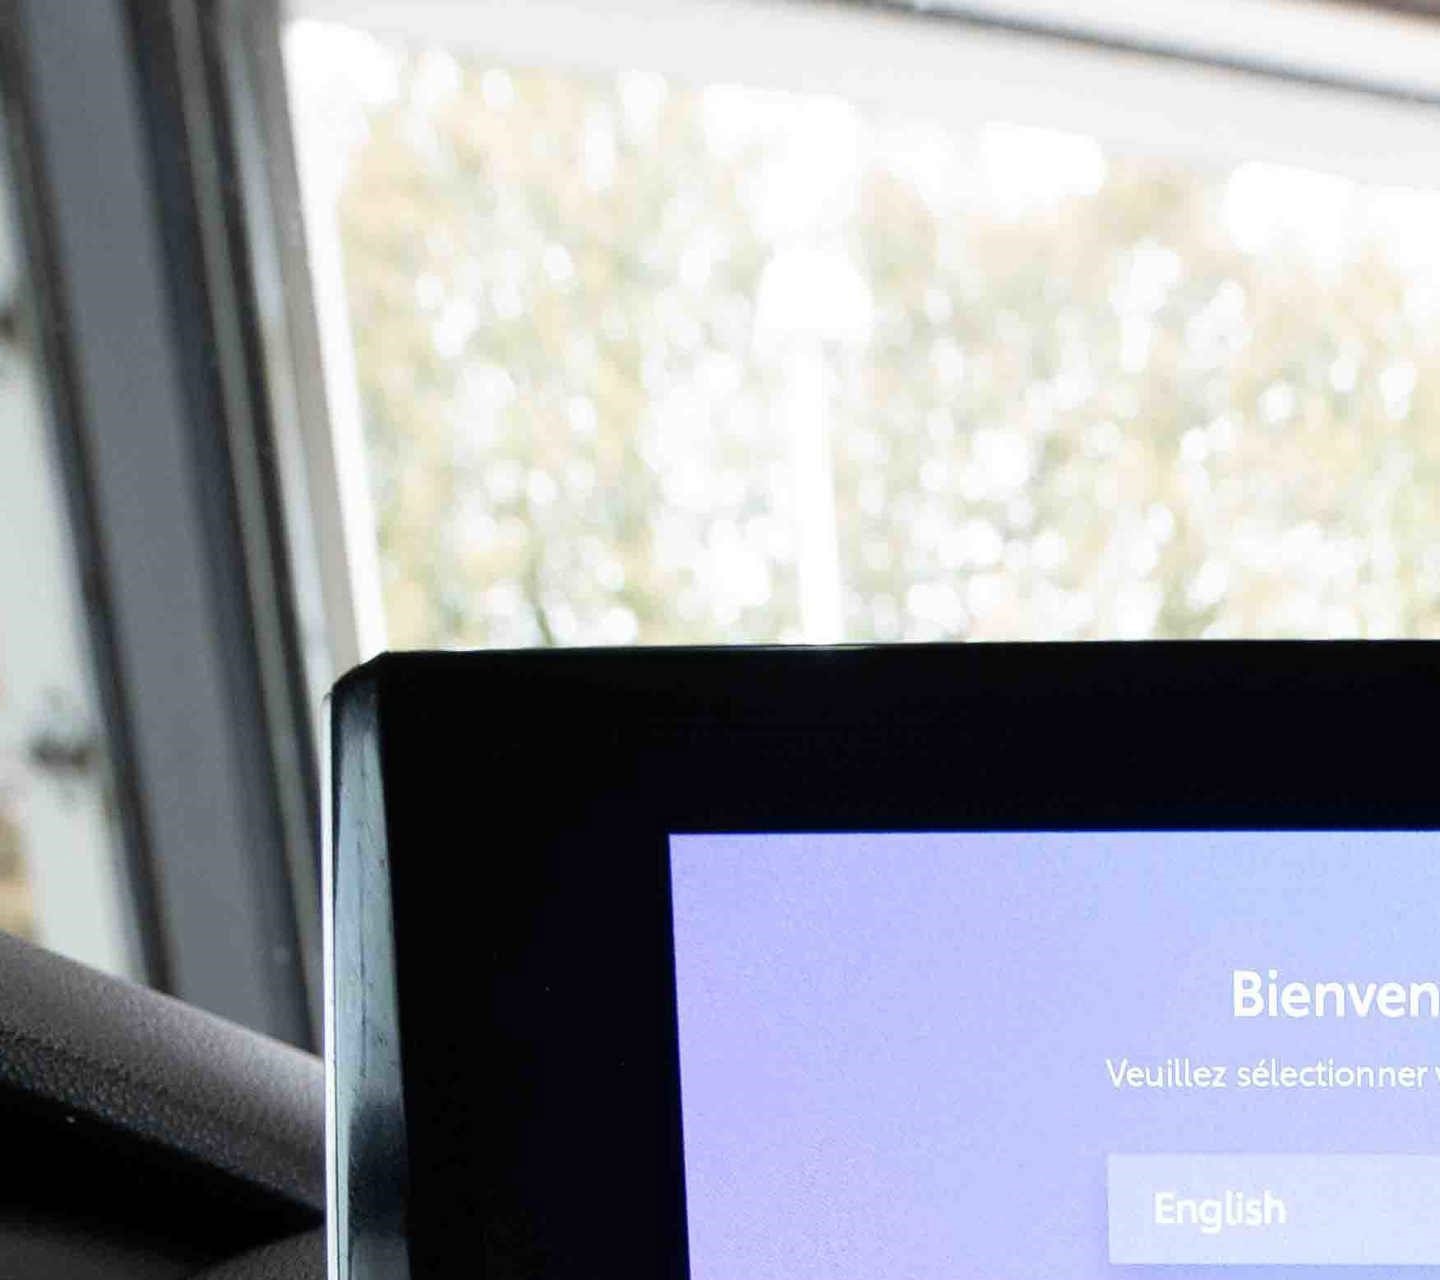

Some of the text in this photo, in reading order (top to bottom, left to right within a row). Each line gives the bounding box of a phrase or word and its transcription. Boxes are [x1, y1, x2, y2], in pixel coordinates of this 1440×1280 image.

[1106, 1059, 1227, 1089] Veuillez
[1237, 1058, 1428, 1089] sélectionner
[1154, 1190, 1287, 1234] English
